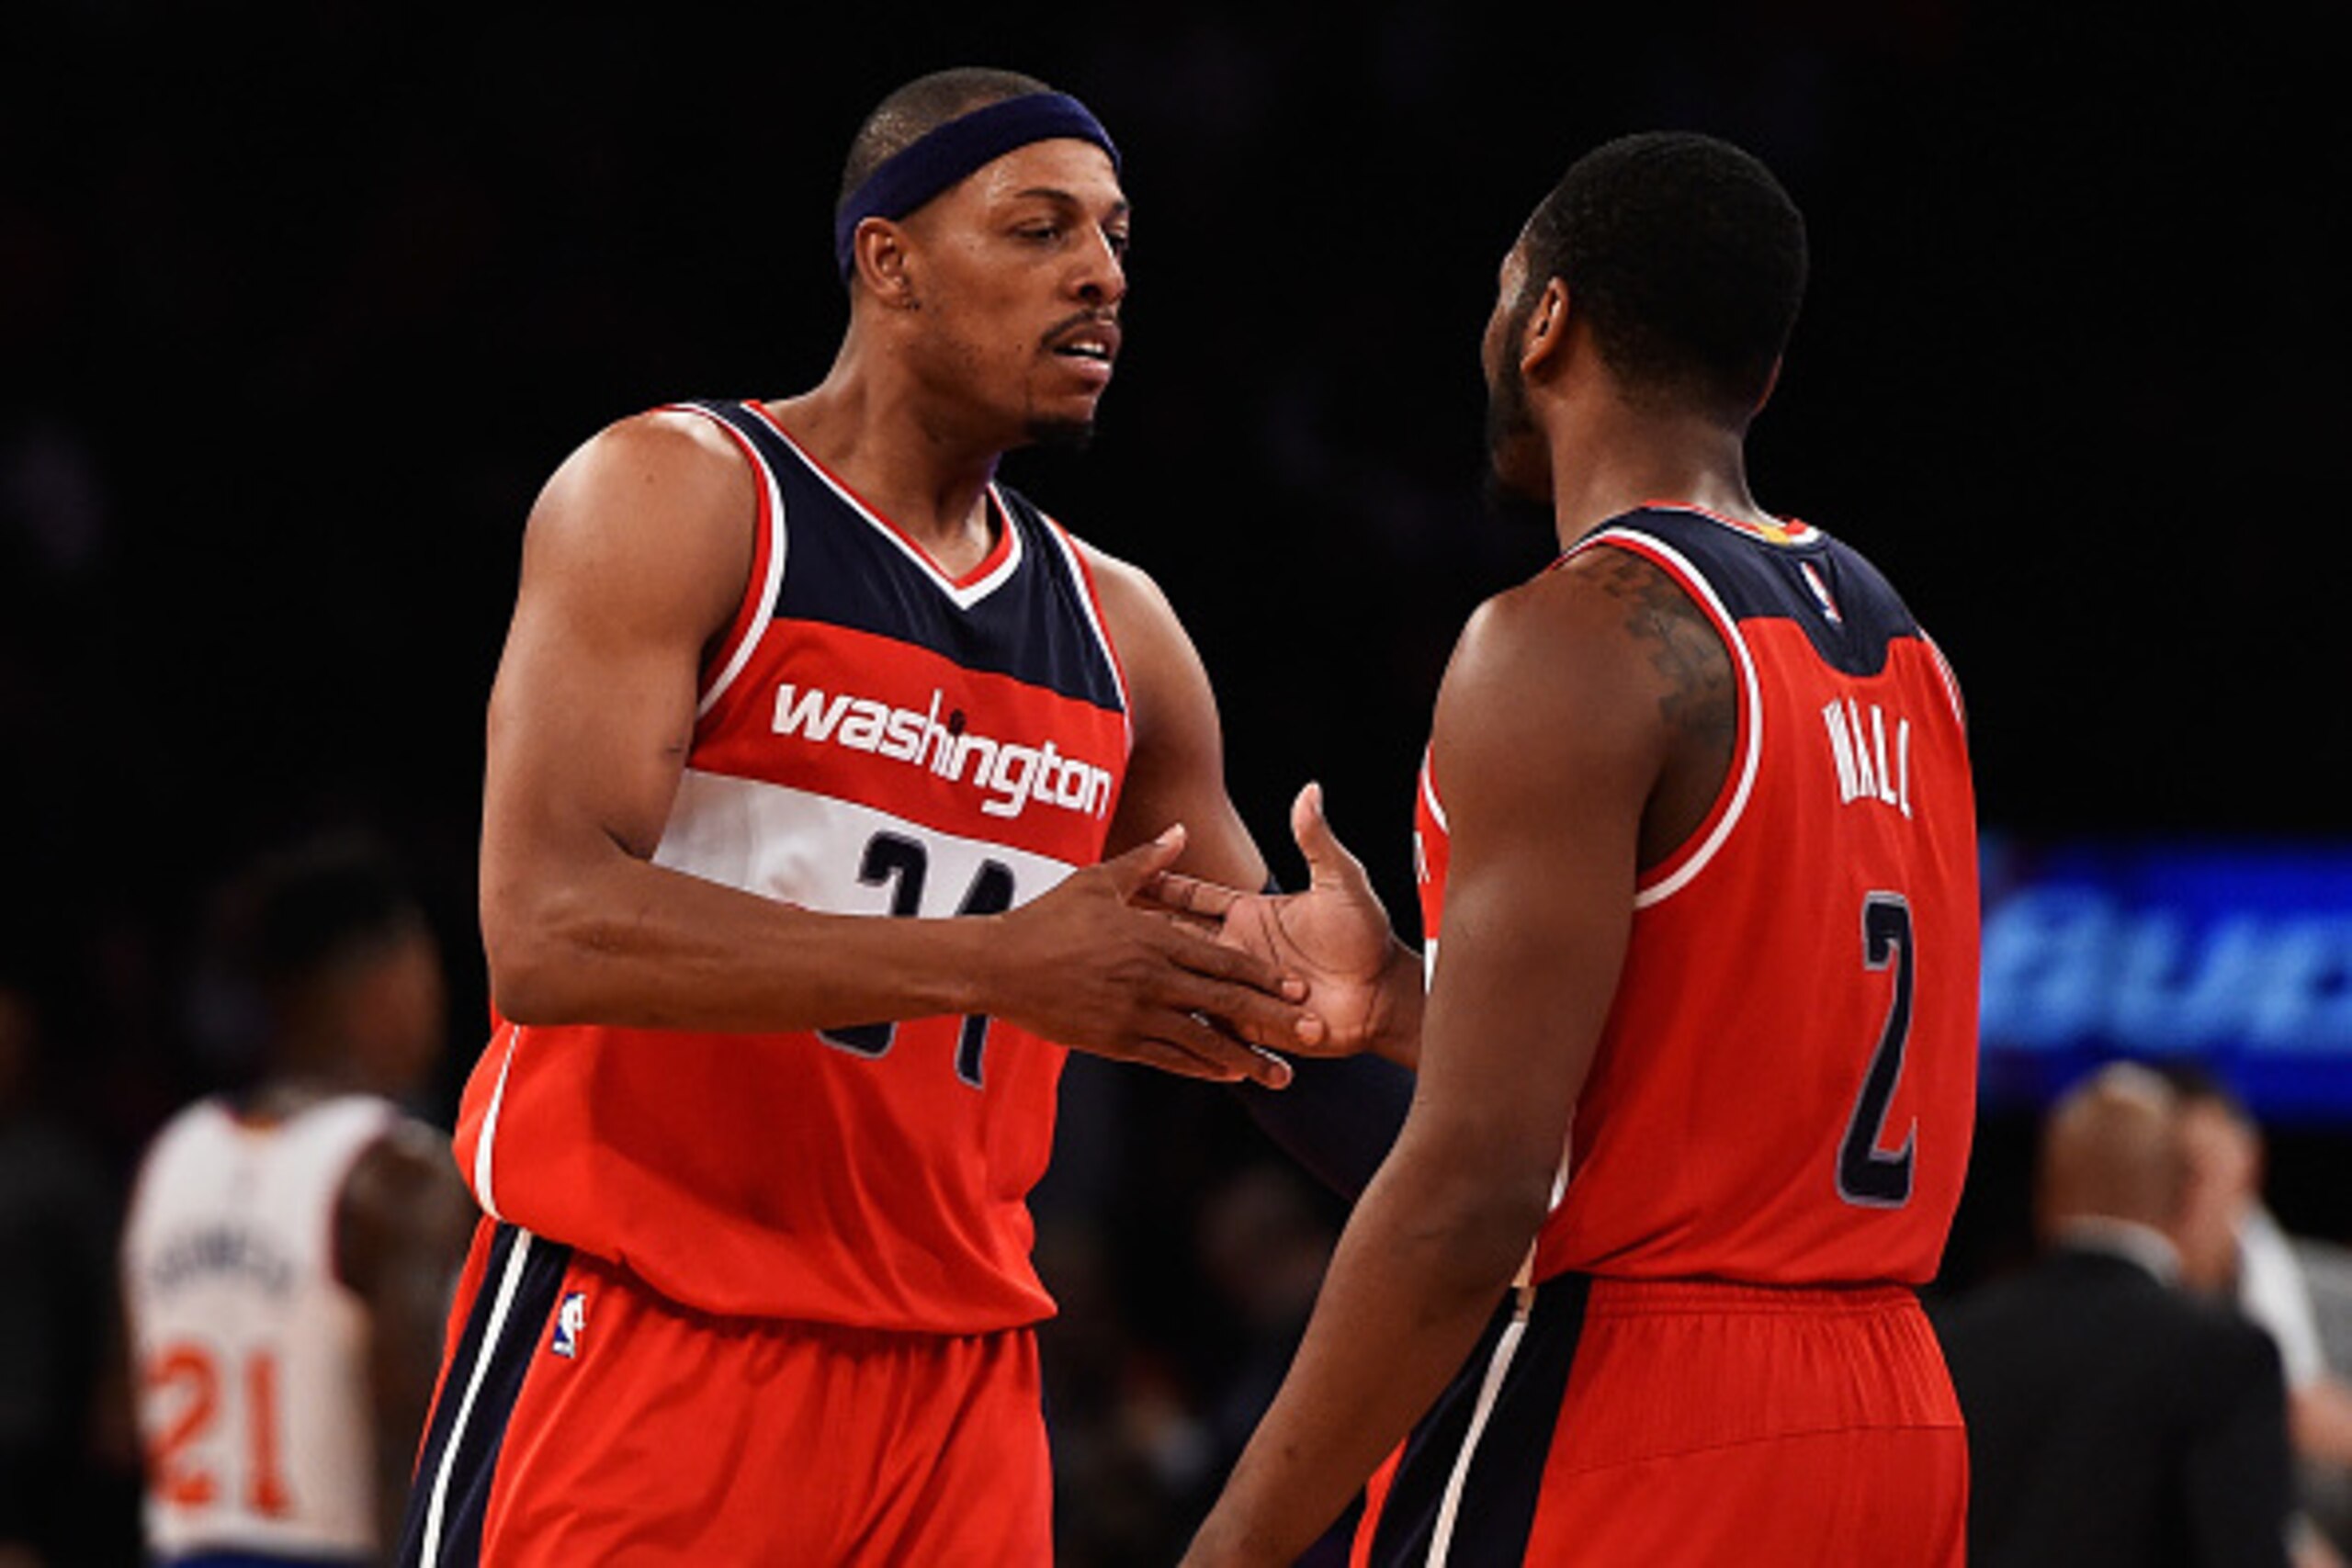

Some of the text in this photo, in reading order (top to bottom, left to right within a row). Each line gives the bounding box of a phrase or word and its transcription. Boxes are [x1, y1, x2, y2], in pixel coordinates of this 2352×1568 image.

[770, 683, 1113, 818] washington
[1835, 890, 1917, 1208] 2
[143, 1338, 292, 1519] 21
